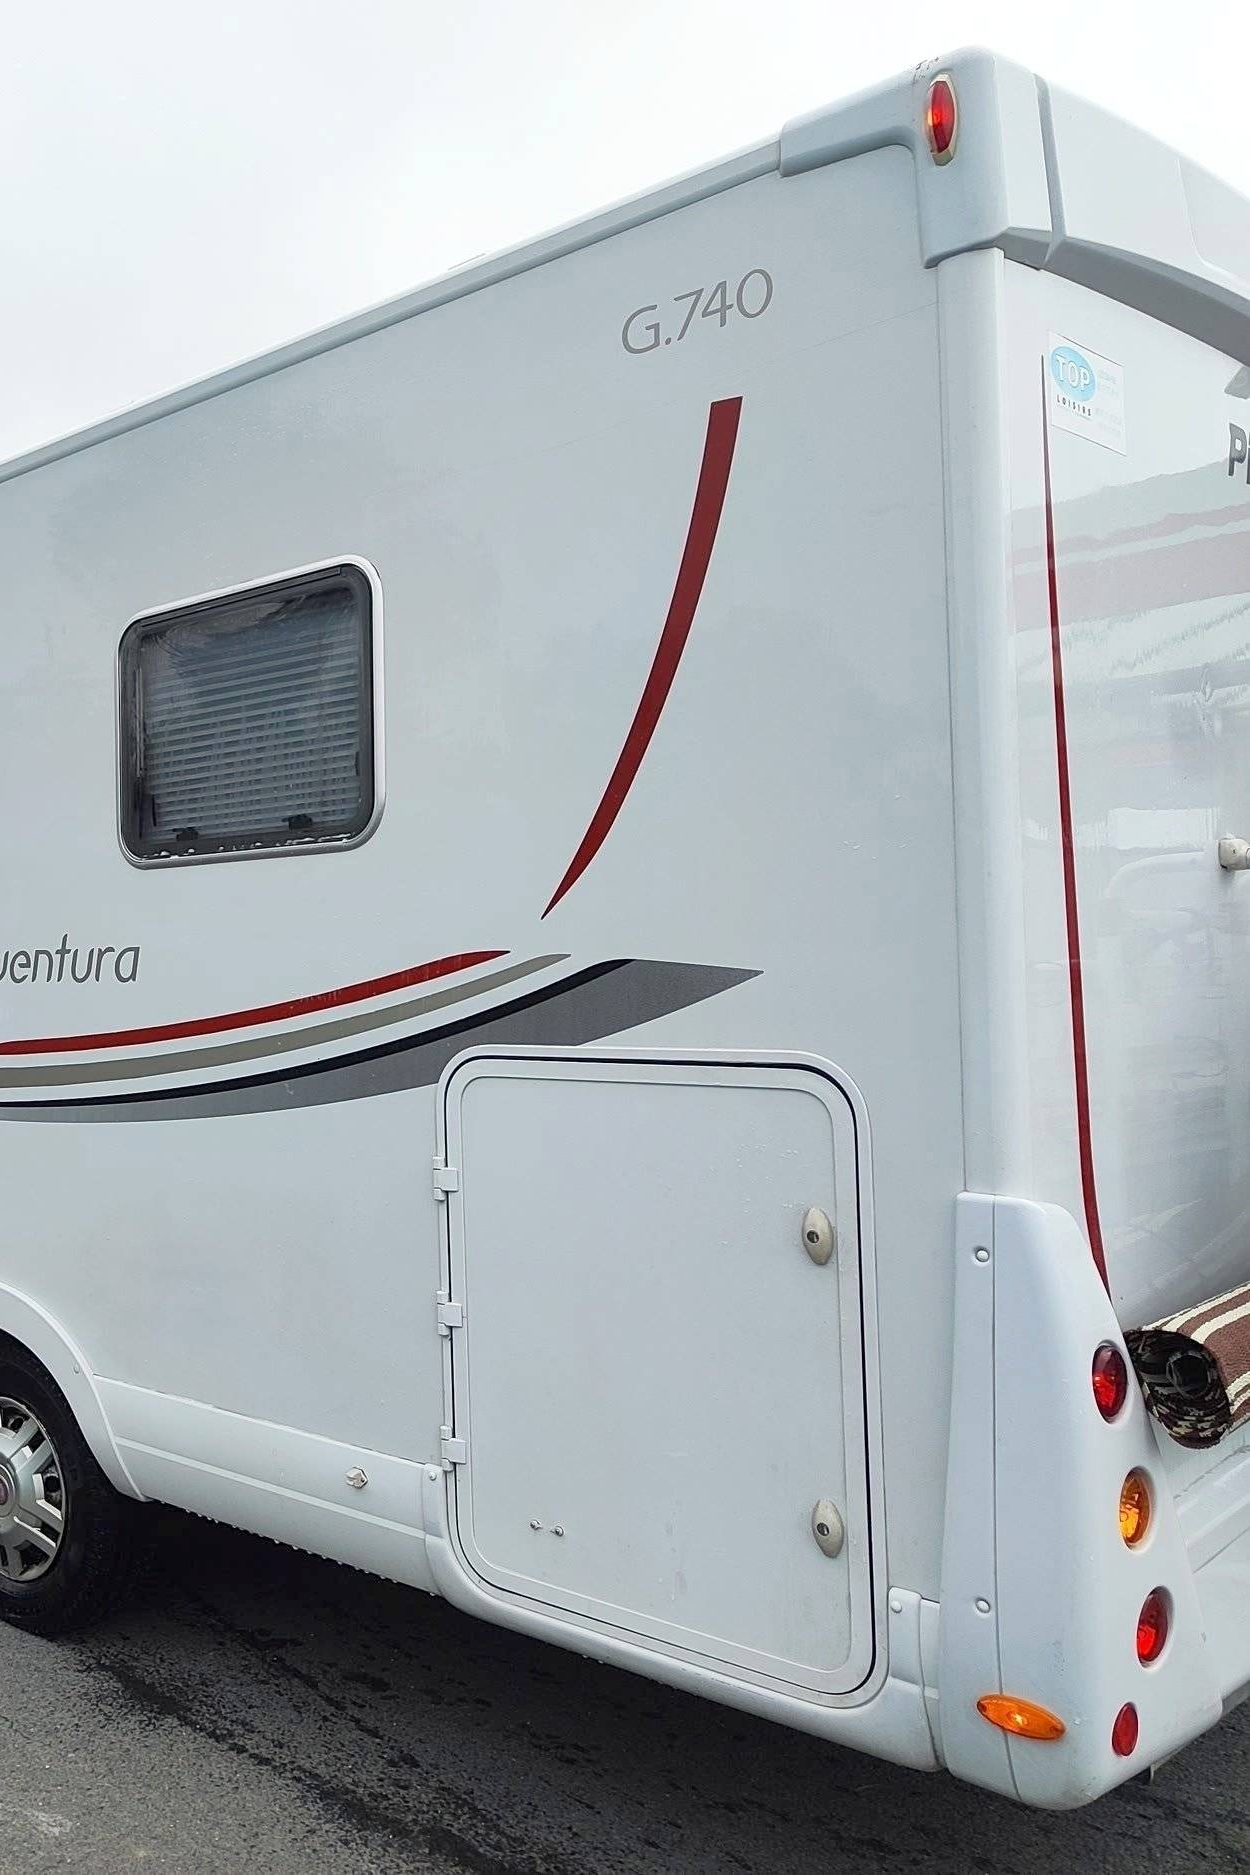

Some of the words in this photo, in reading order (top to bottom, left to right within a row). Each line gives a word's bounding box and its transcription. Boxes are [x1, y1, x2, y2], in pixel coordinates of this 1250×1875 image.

[621, 268, 774, 355] G.740
[1055, 354, 1090, 391] TOP
[1056, 394, 1092, 417] LOISIRS
